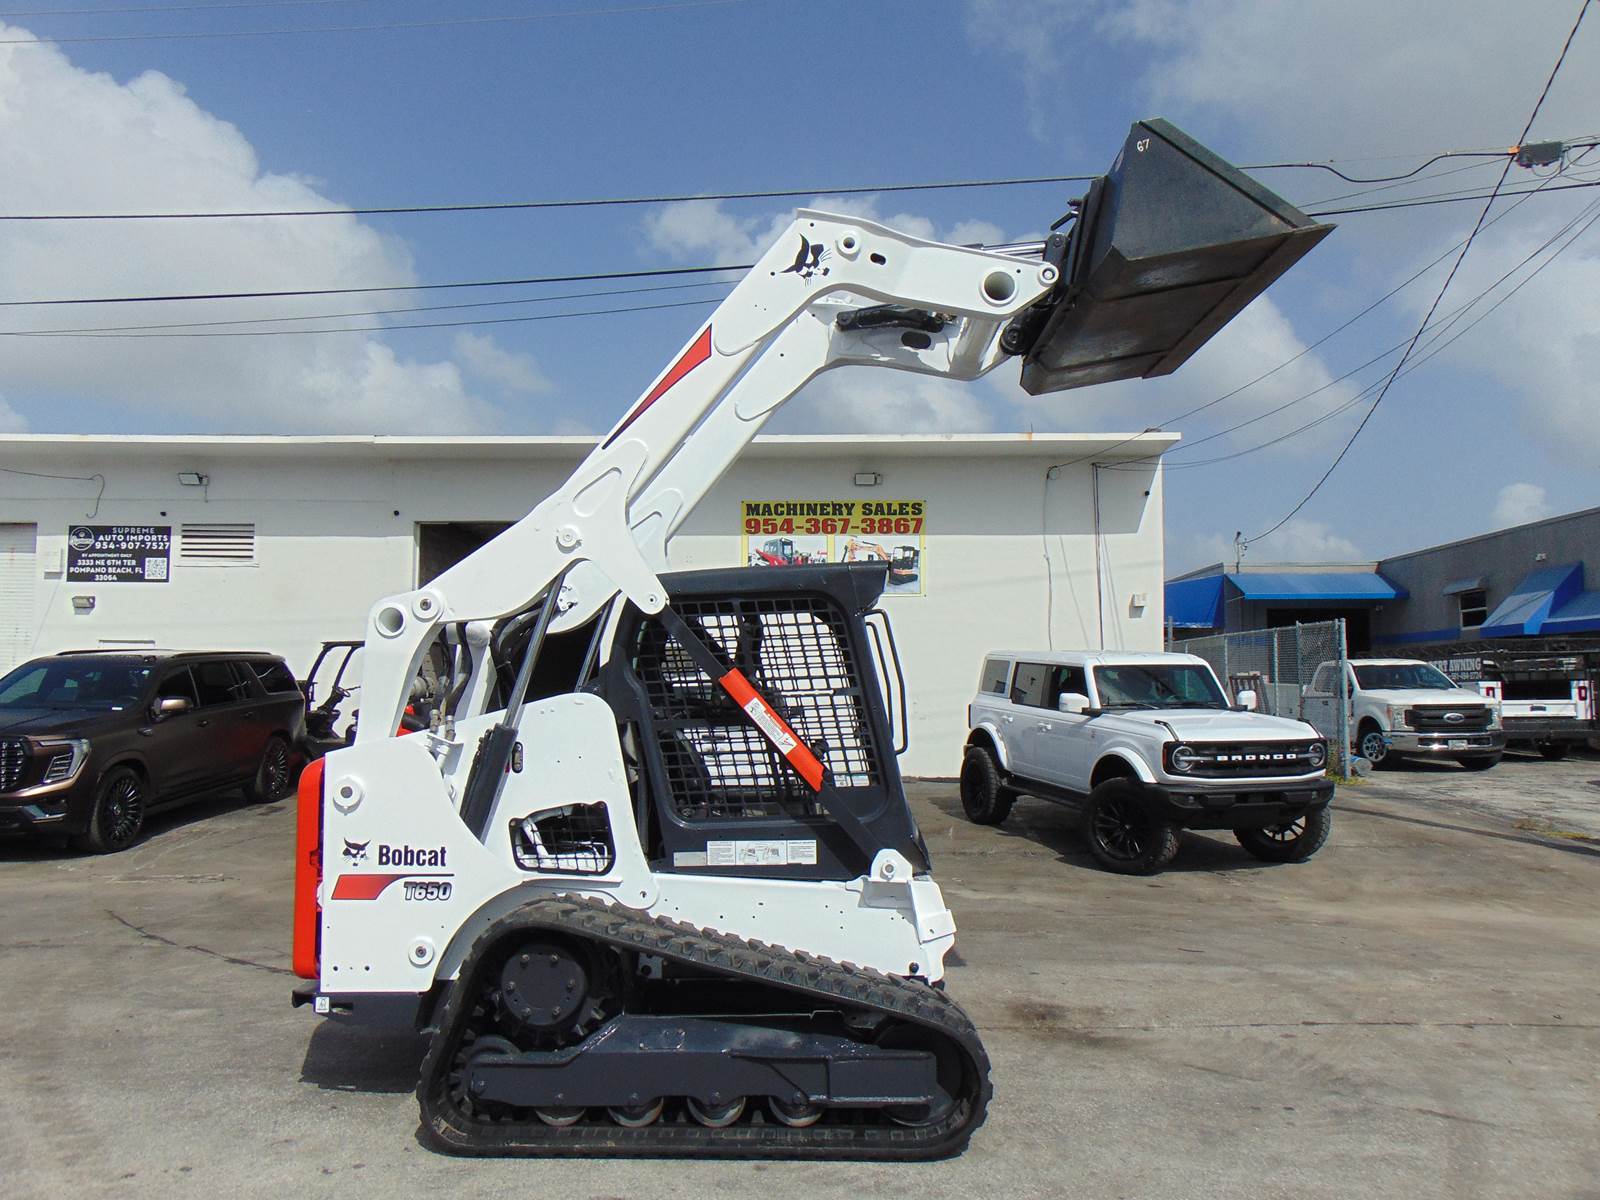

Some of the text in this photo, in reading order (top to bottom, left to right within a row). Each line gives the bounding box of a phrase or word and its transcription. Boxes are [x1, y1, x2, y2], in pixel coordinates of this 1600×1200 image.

[1136, 138, 1150, 152] 67
[746, 502, 923, 517] MACHINERY SALES
[745, 517, 923, 535] 954-367-3867
[95, 541, 170, 549] 954-907-7527
[1216, 753, 1297, 761] BRONCO
[378, 845, 447, 867] Bobcat
[404, 881, 452, 901] T650
